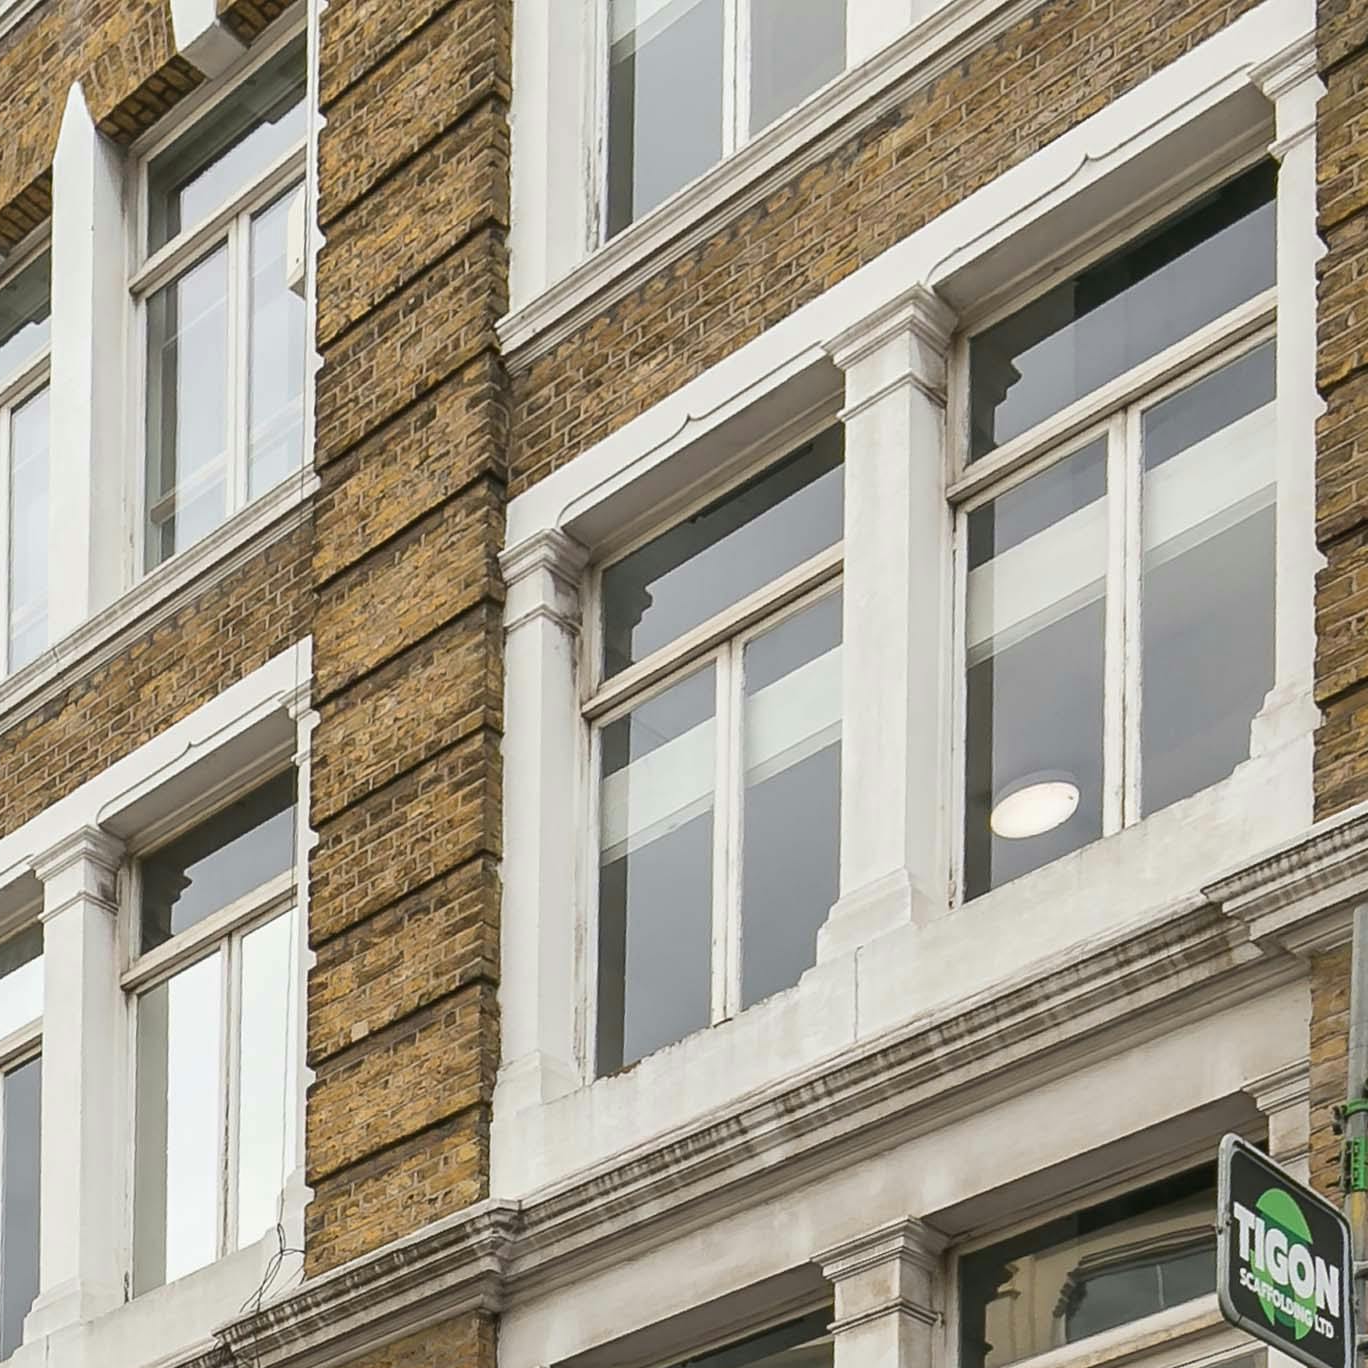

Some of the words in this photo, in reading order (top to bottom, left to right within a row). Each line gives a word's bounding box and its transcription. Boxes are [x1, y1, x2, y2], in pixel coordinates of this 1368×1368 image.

[1233, 1202, 1339, 1318] TIGON
[1239, 1267, 1313, 1324] SCAFFOLDING
[1314, 1312, 1334, 1339] LTD
